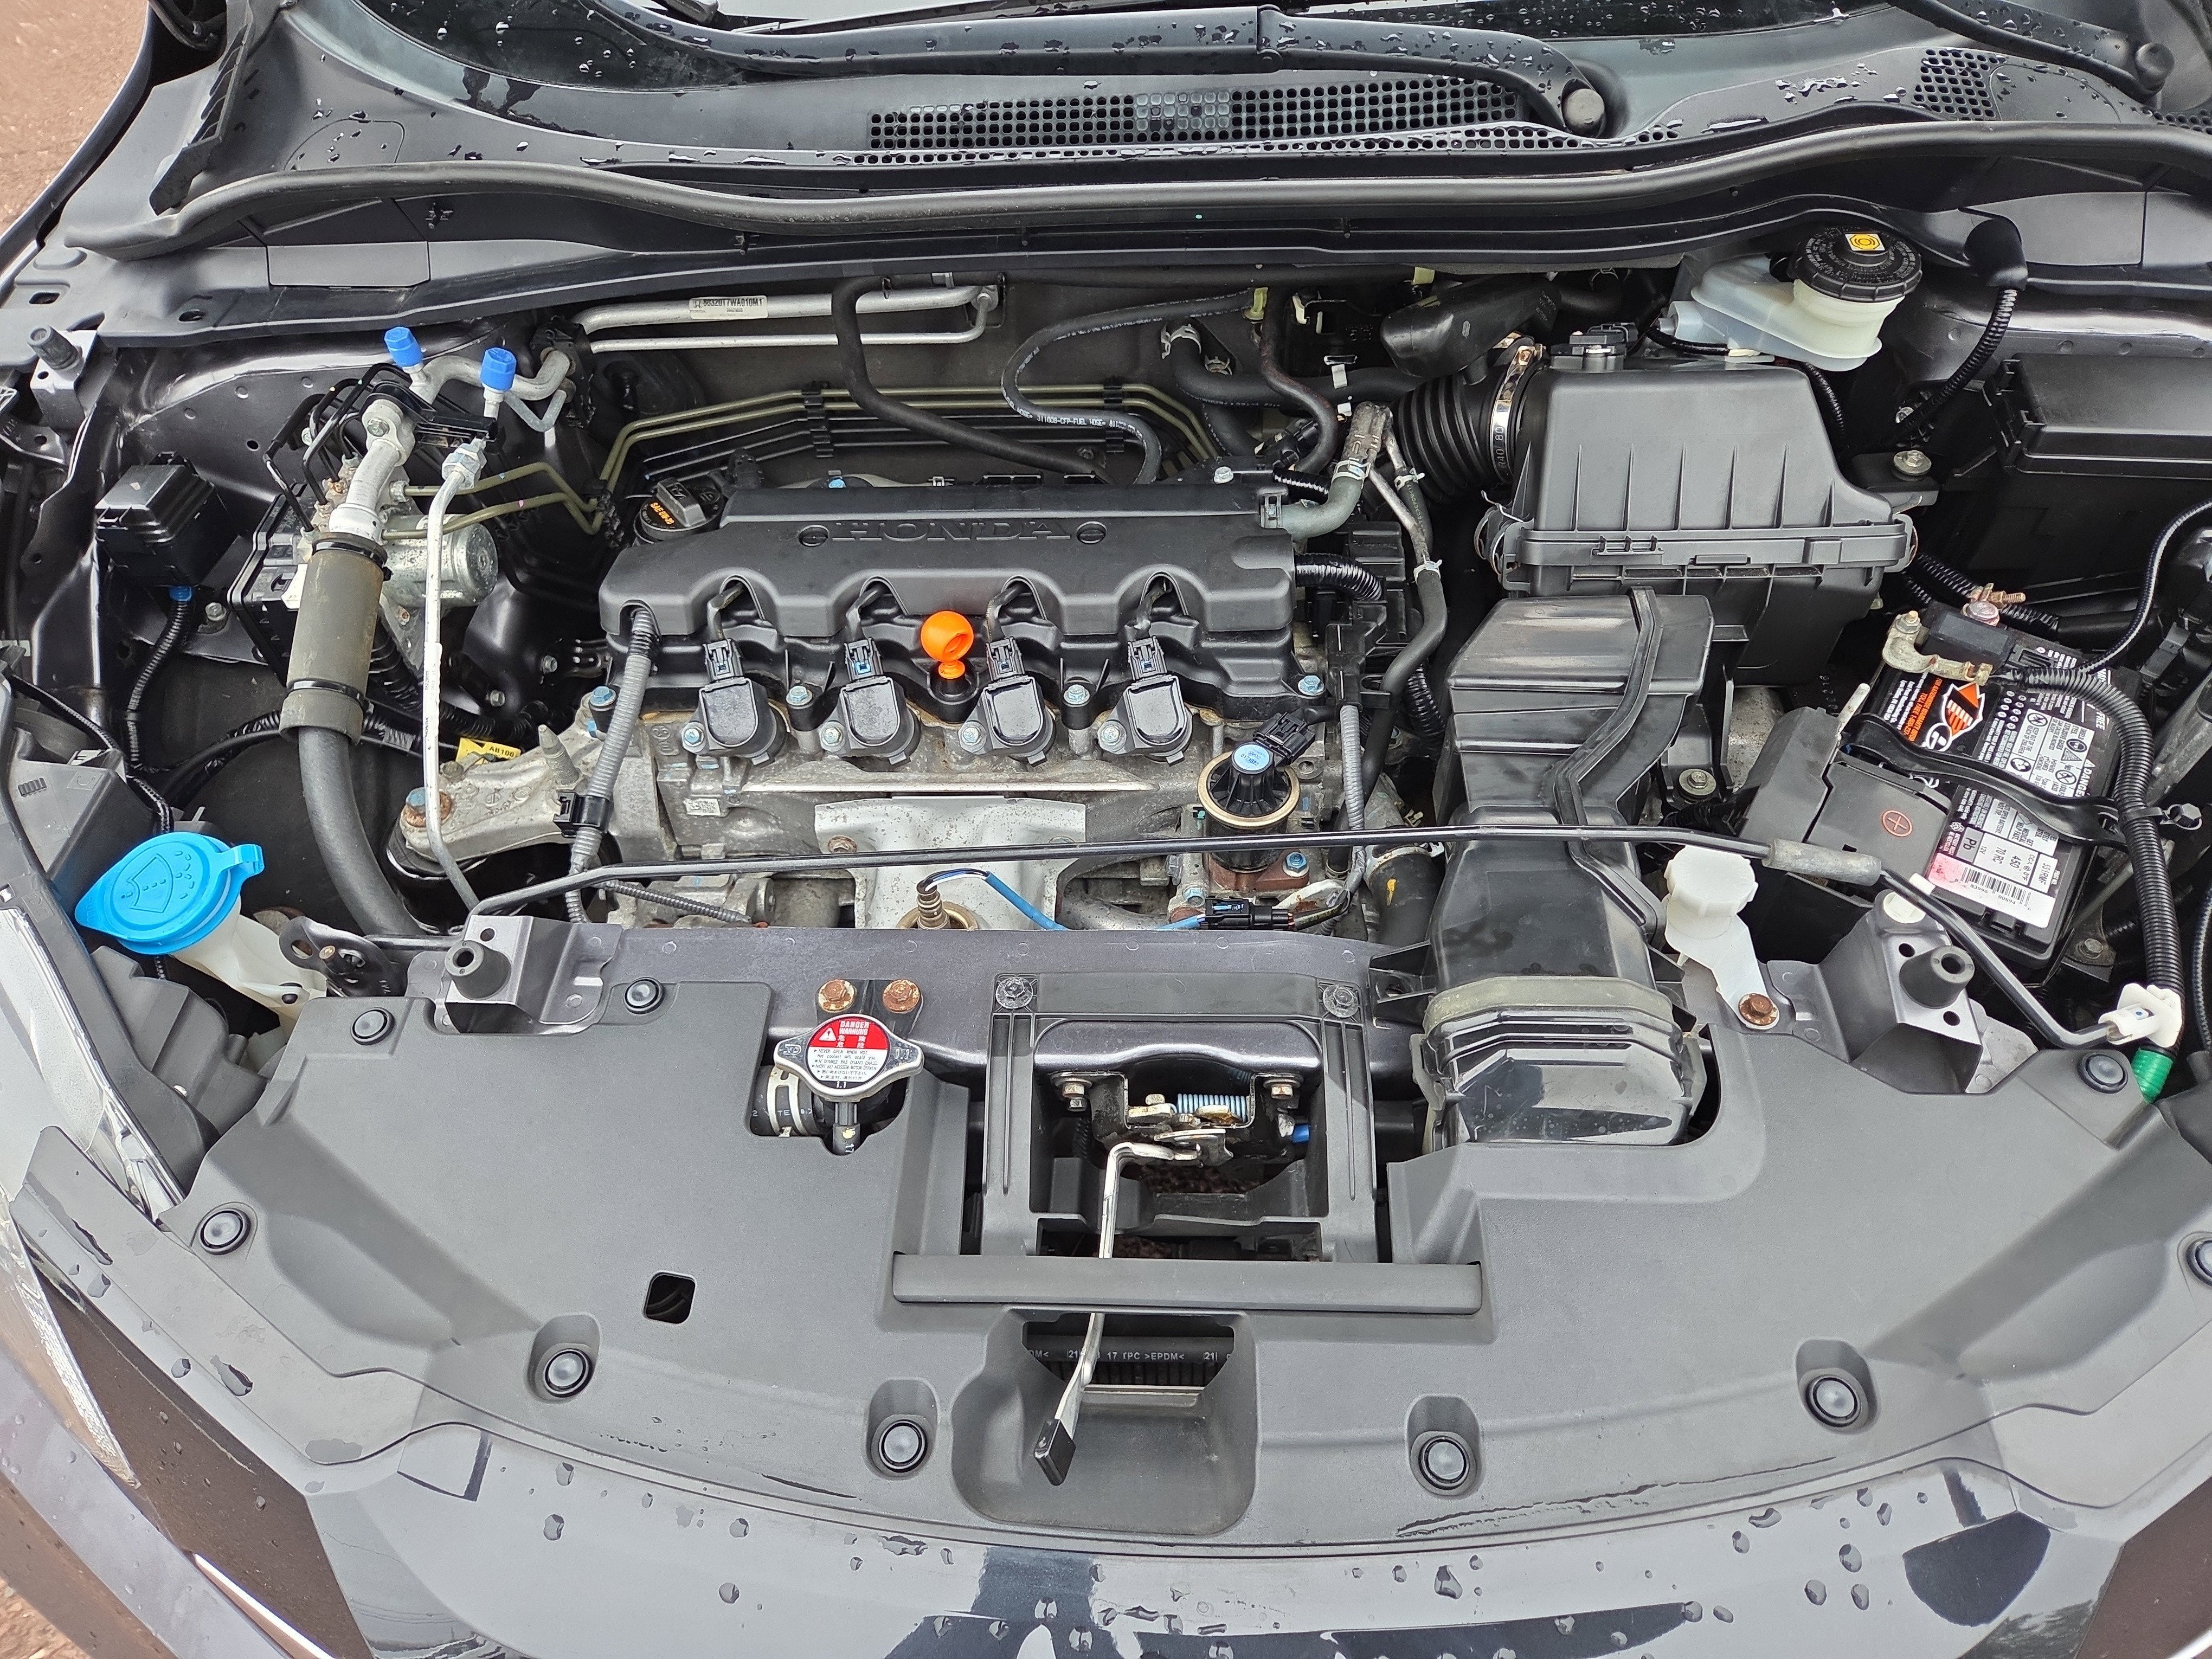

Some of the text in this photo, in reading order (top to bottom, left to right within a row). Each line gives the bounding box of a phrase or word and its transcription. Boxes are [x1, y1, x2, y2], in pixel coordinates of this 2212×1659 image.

[650, 502, 663, 513] SAE
[832, 522, 1071, 541] HONDA
[489, 746, 514, 757] AB100
[1963, 838, 1977, 851] Pb
[1993, 847, 2005, 864] 70 RC
[2027, 854, 2035, 865] CCA
[2039, 863, 2051, 885] 551RMF
[837, 1081, 847, 1089] 1.1
[1144, 1352, 1185, 1361] >EPDM<
